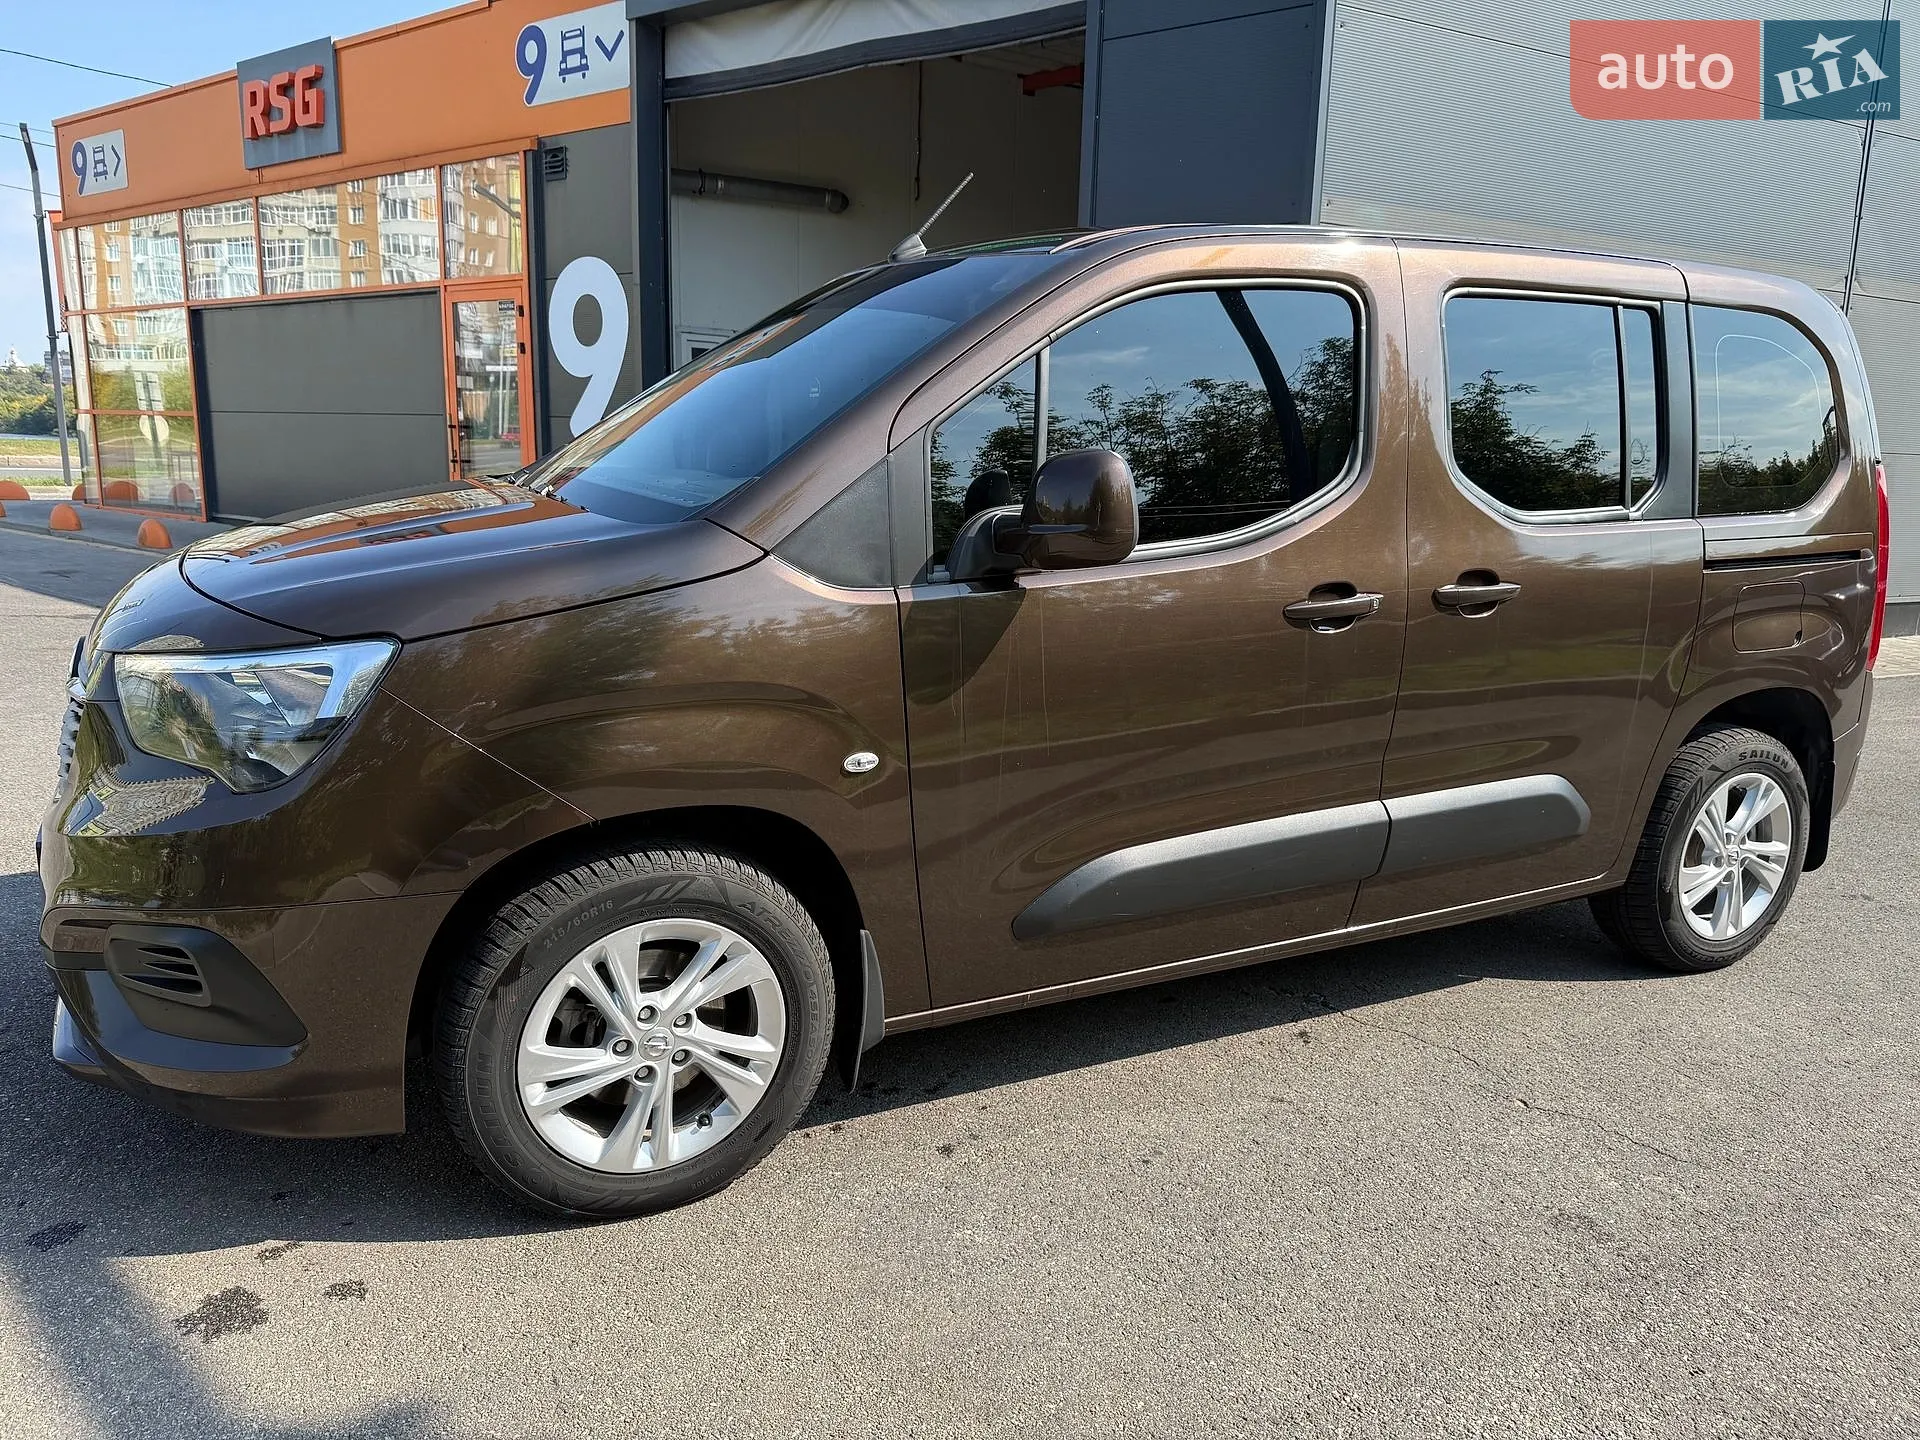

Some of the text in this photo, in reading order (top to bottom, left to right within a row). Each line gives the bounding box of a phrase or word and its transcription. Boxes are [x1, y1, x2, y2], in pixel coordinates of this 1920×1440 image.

[516, 25, 547, 105] 9
[243, 64, 324, 140] RSG
[72, 141, 87, 195] 9
[549, 256, 629, 438] 9
[1738, 749, 1789, 769] SAILUN
[543, 900, 614, 950] 215/60R16
